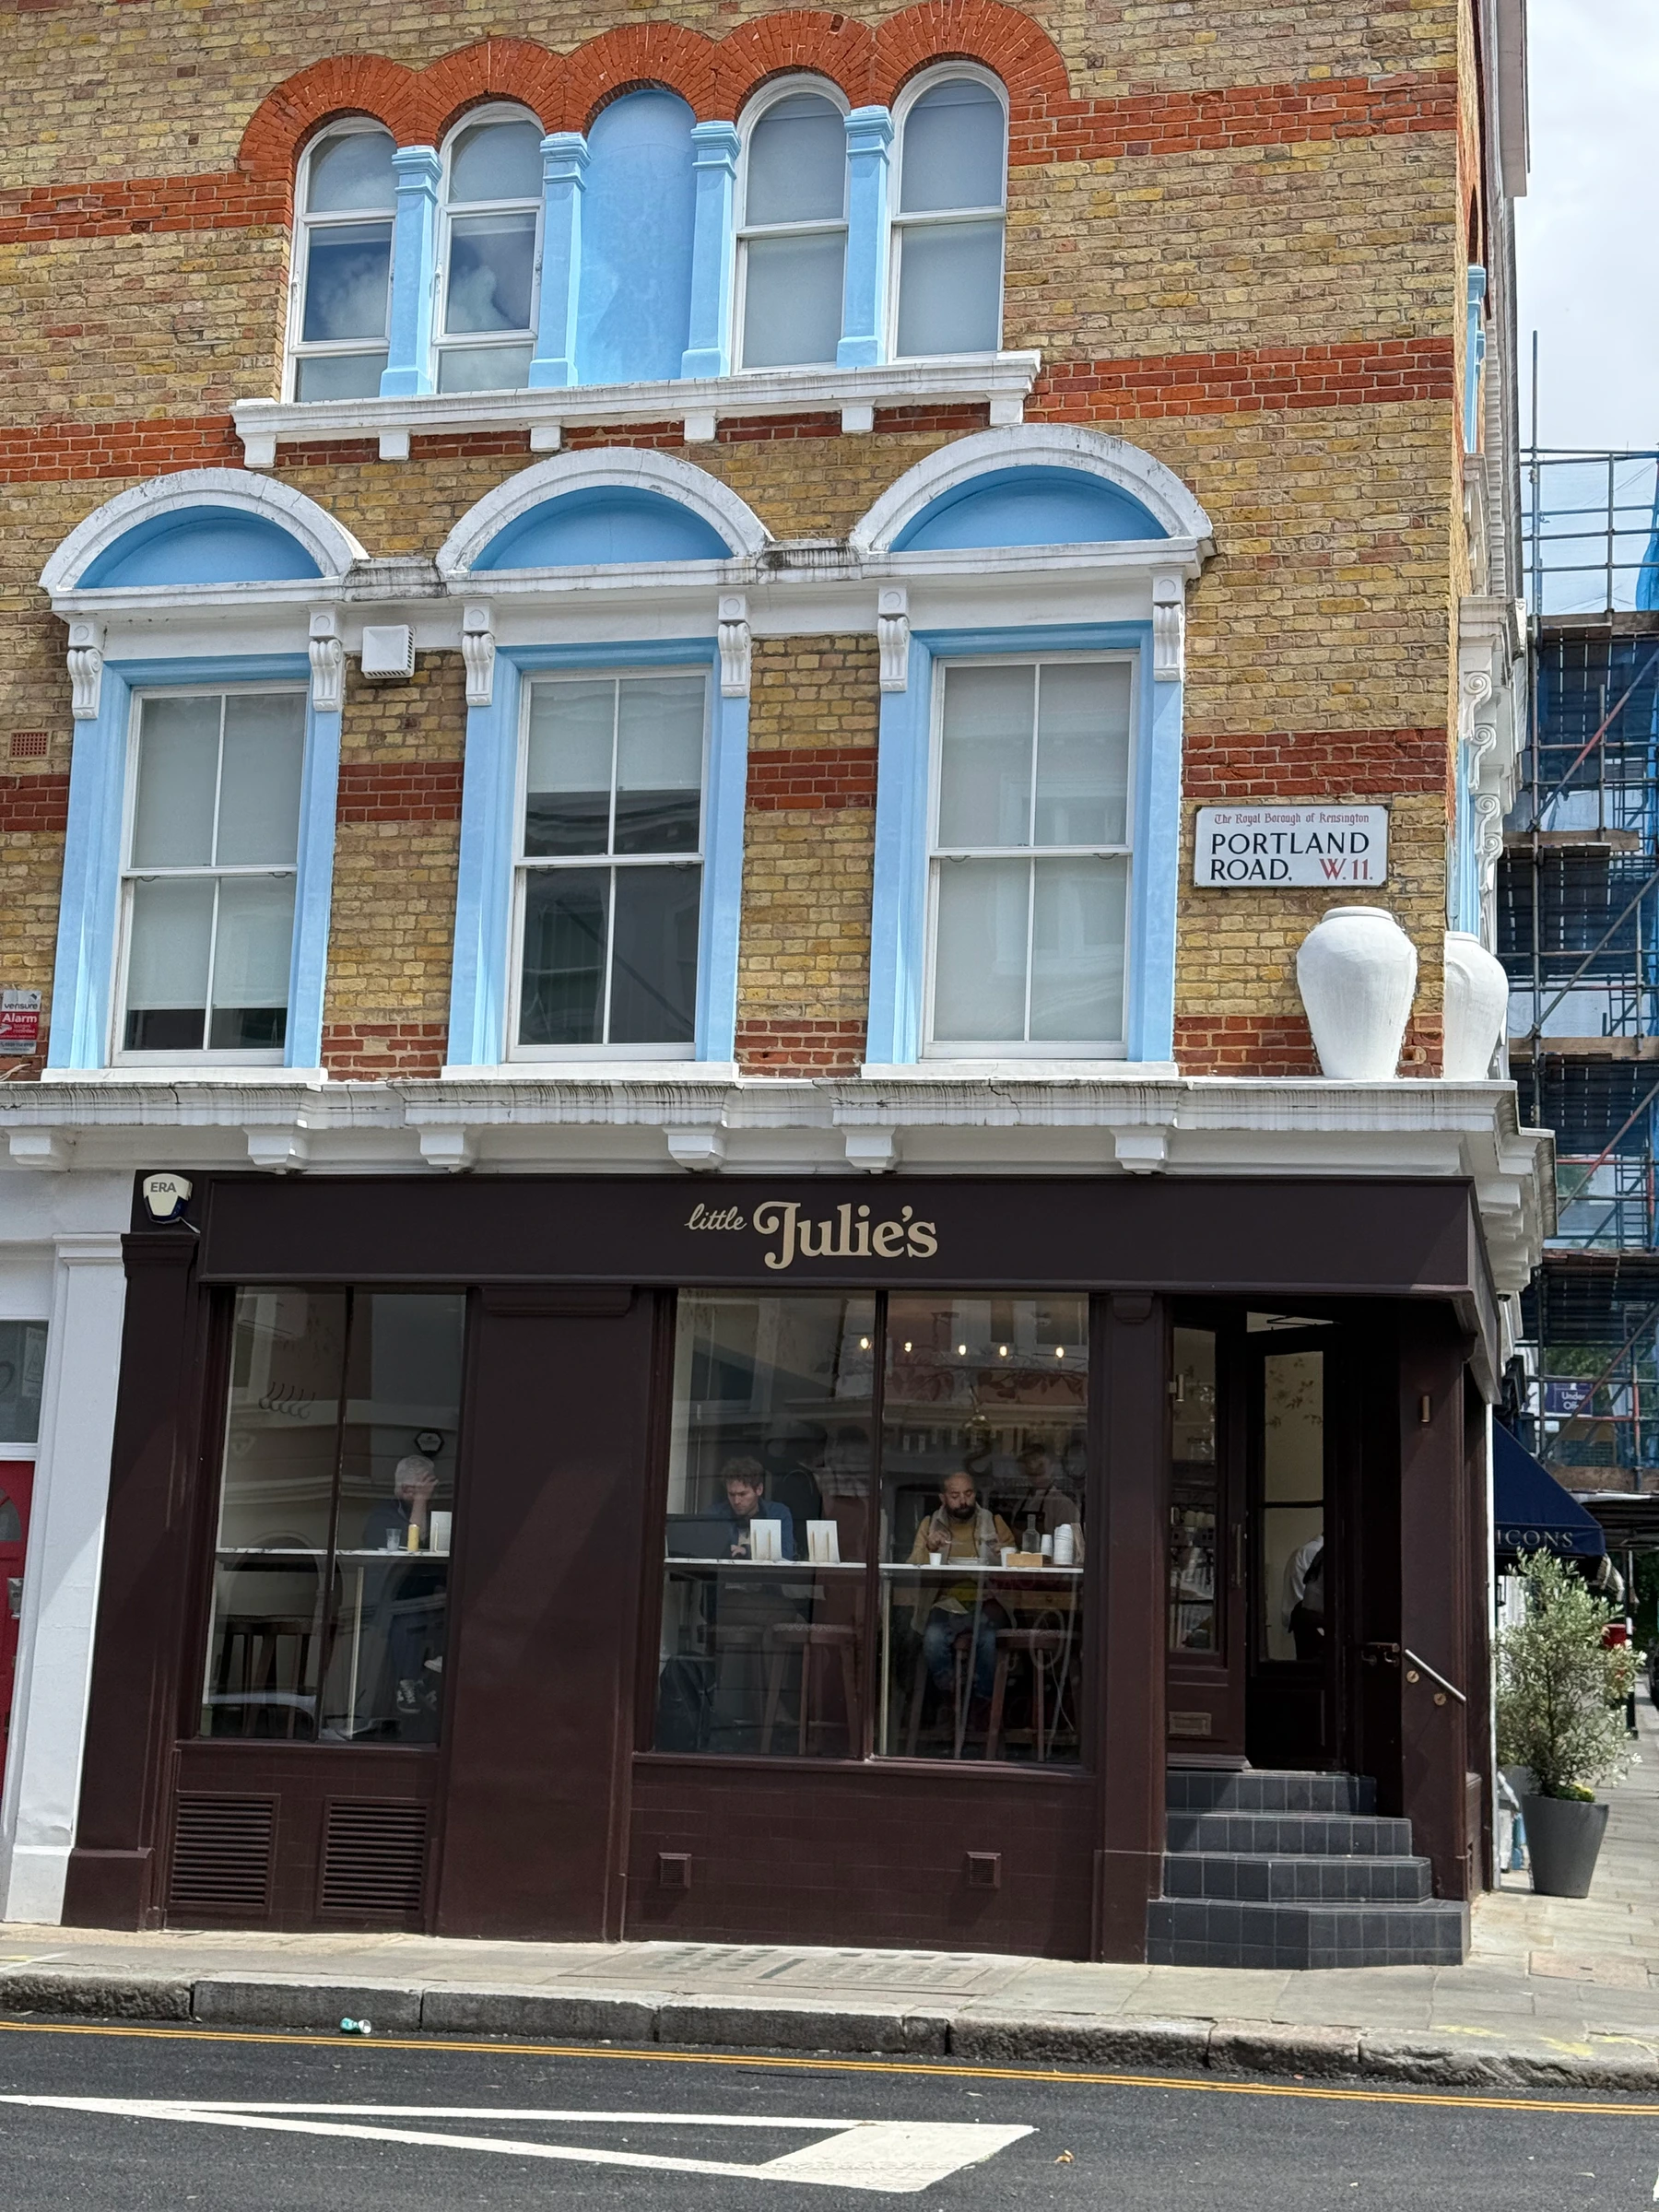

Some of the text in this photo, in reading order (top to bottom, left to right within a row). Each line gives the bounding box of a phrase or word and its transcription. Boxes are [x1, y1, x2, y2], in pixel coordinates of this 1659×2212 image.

[1214, 811, 1370, 827] The Royal Borough of Kensington
[1211, 831, 1370, 855] PORTLAND
[2, 1013, 37, 1023] Alarm
[150, 1182, 177, 1193] ERA
[685, 1201, 938, 1270] little Julie's
[1497, 1529, 1573, 1548] ICONS
